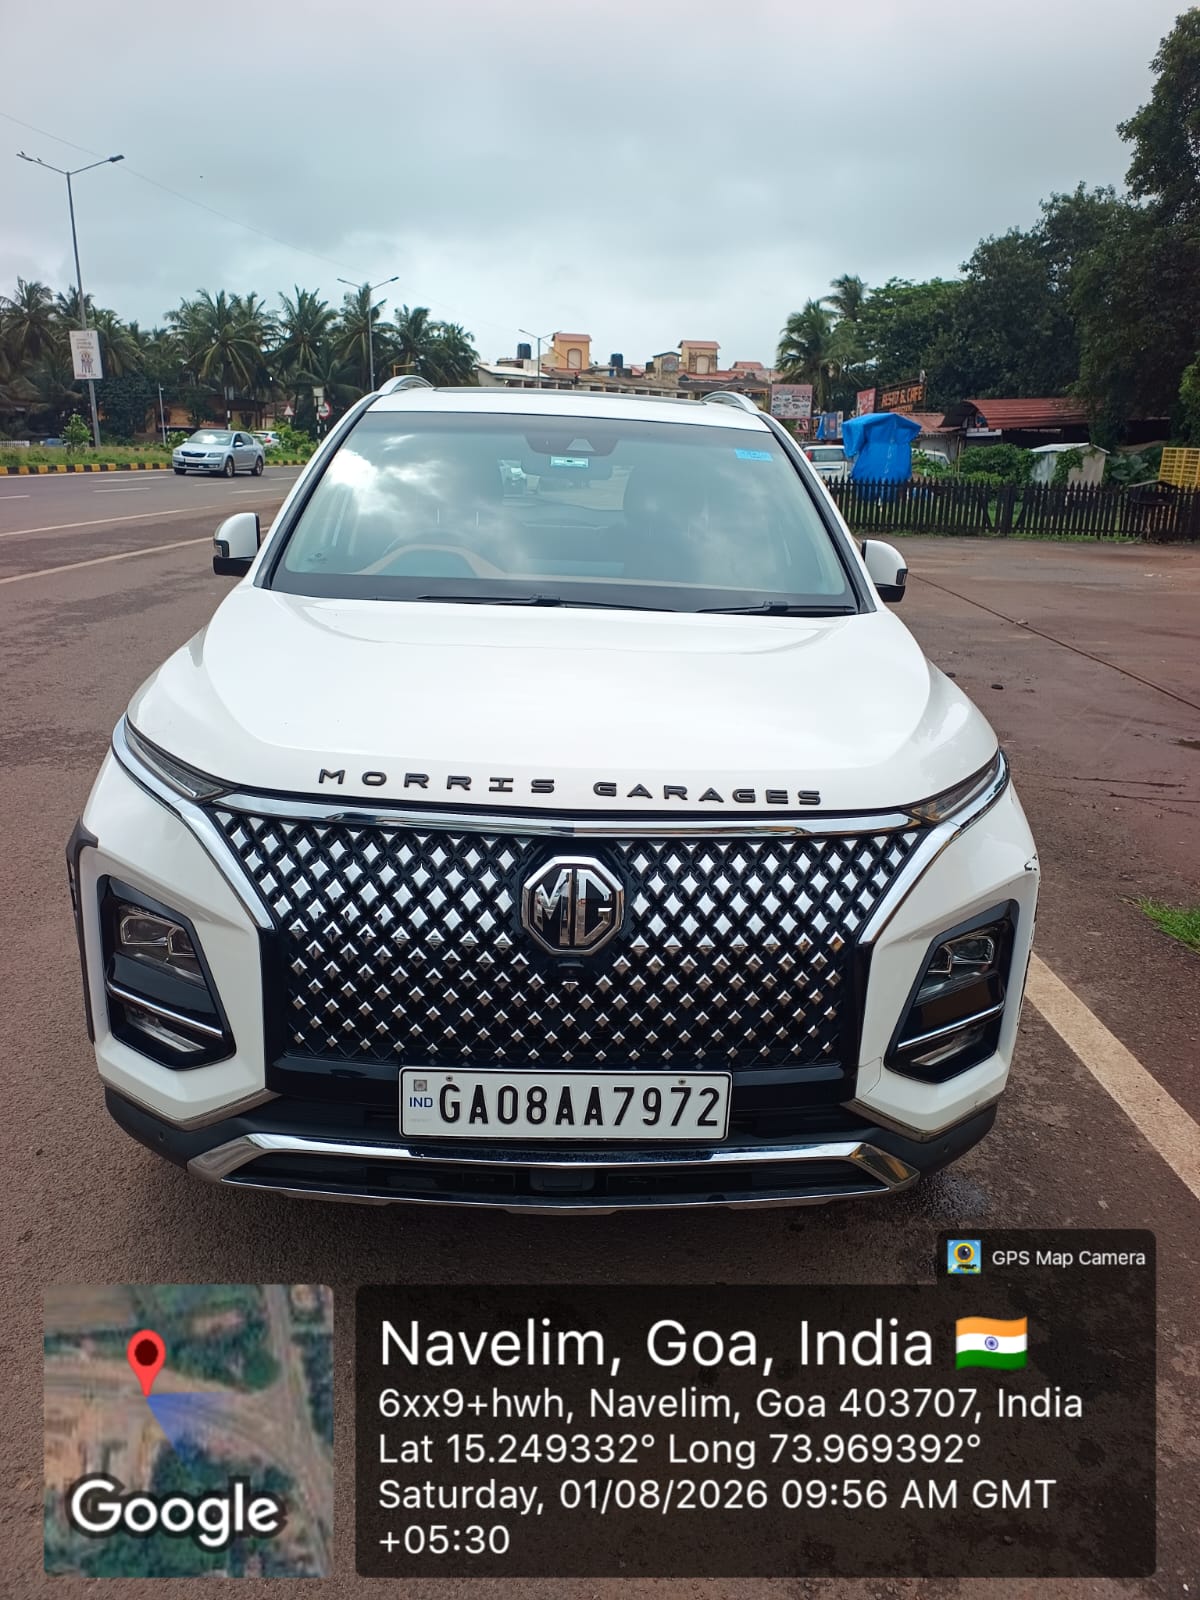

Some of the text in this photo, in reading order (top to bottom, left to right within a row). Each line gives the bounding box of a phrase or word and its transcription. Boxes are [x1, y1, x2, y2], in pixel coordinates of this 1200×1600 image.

[318, 769, 822, 806] MORRIS GARAGES
[534, 868, 613, 946] MG
[409, 1096, 433, 1108] IND
[439, 1083, 720, 1127] GA08AA7972
